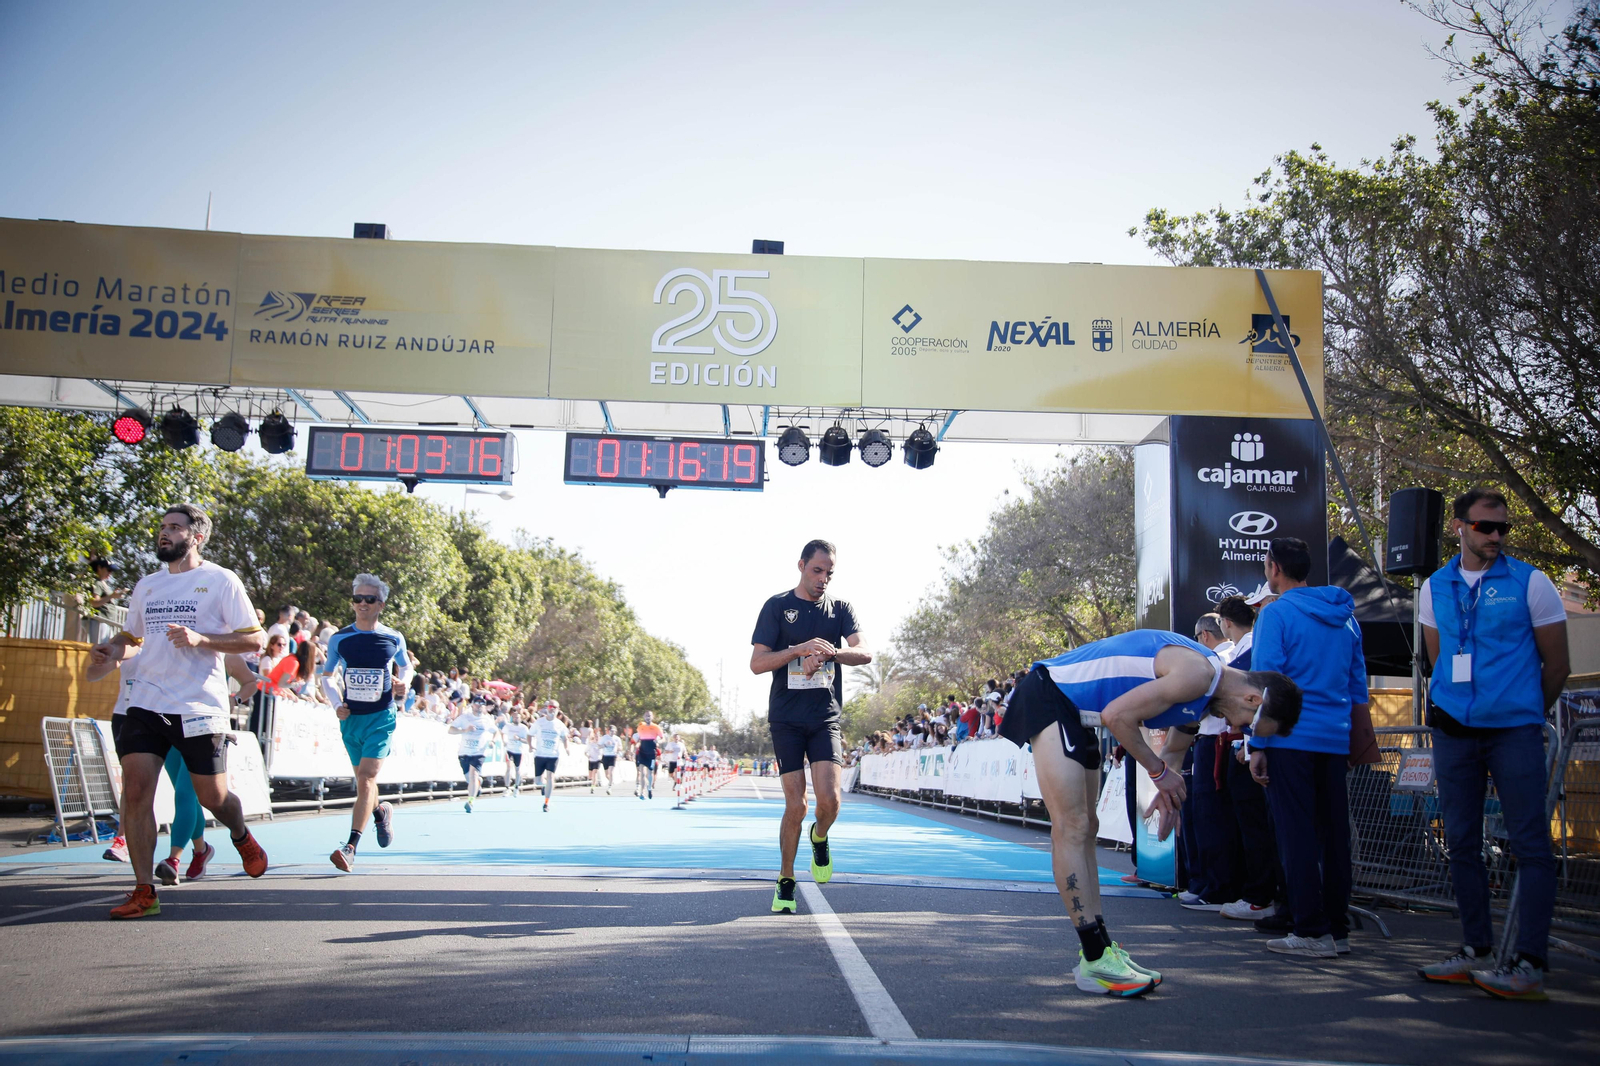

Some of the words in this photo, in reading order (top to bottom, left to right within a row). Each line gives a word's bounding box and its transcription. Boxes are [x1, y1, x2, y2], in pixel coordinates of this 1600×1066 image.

[0, 270, 79, 297] edio
[95, 276, 231, 306] Maratón
[316, 294, 367, 306] RFEA
[311, 307, 361, 316] SERIES
[651, 267, 778, 357] 25
[0, 300, 121, 336] lmería
[129, 308, 229, 341] 2024
[306, 316, 337, 324] RUTA
[340, 317, 389, 326] RUNNING
[1132, 318, 1221, 338] ALMERÍA
[250, 328, 328, 347] RAMÓN
[338, 333, 387, 349] RUIZ
[395, 335, 495, 354] ANDÚJAR
[891, 336, 968, 348] COOPERACIÓN
[1132, 339, 1178, 350] CIUDAD
[891, 346, 917, 356] 2005
[650, 359, 777, 388] EDICIÓN
[1197, 462, 1299, 489] cajamar
[1246, 484, 1267, 493] CAJA
[1269, 485, 1296, 494] RURAL
[349, 674, 379, 685] 5052
[1401, 771, 1430, 782] EVENTOS
